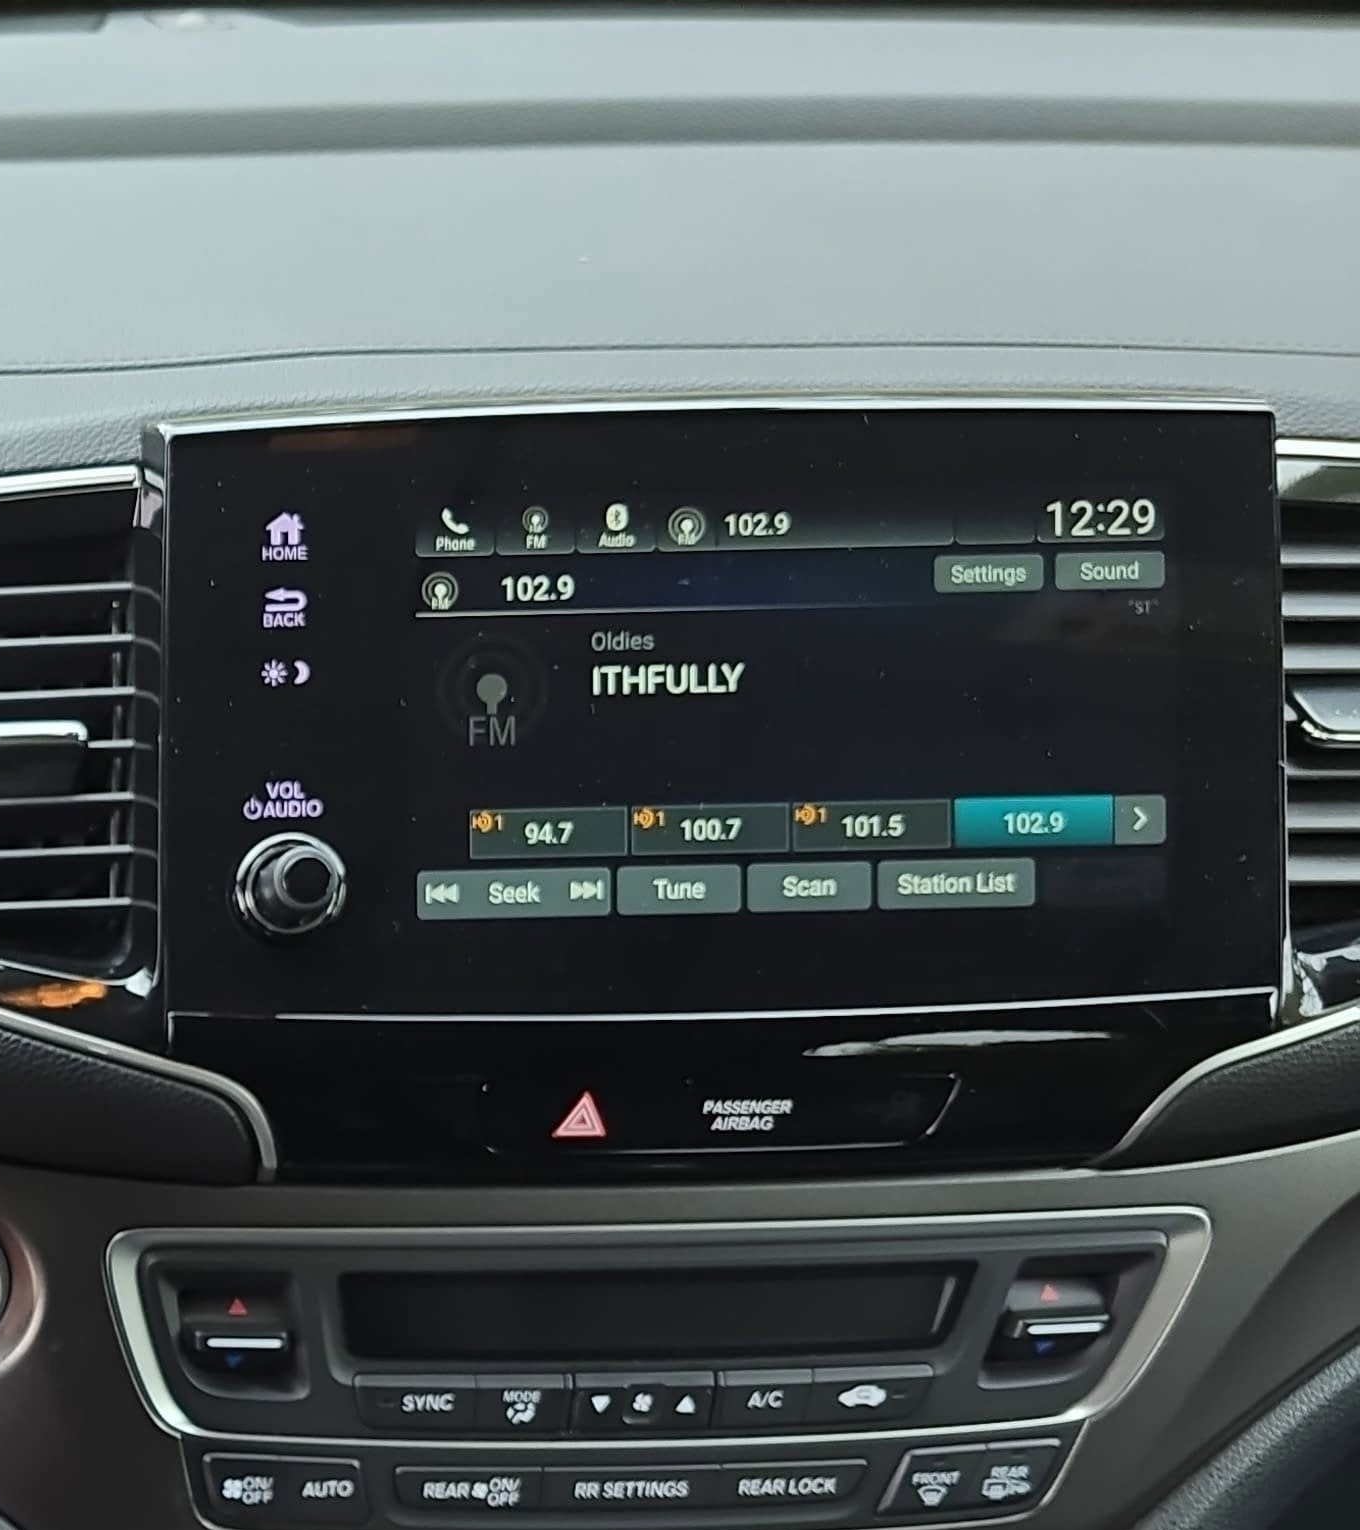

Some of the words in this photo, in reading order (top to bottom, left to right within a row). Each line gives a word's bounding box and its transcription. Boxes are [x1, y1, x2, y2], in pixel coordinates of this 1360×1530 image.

[724, 512, 791, 536] 102.9
[1046, 499, 1156, 537] 12:29
[436, 536, 475, 551] Phone
[526, 535, 546, 549] FM
[599, 532, 634, 547] Audio
[262, 546, 308, 561] HOME
[951, 565, 1026, 586] Settings
[1080, 560, 1140, 581] Sound
[500, 575, 575, 601] 102.9
[263, 613, 306, 627] BACK
[591, 632, 655, 651] Oldies
[591, 663, 745, 696] ITHFULLY
[468, 715, 516, 746] FM
[265, 782, 305, 799] VOL
[263, 801, 324, 818] AUDIO
[680, 817, 743, 842] 100.7
[841, 813, 905, 838] 101.5
[1003, 811, 1065, 834] 102.9
[525, 822, 574, 845] 94.7
[488, 881, 541, 904] Seek
[652, 878, 707, 900] Tune
[782, 876, 837, 897] Scan
[897, 873, 971, 895] Station
[977, 872, 1015, 893] List
[703, 1099, 793, 1114] PASSENGER
[711, 1116, 773, 1131] AIRBAG
[401, 1394, 456, 1412] SYNC
[503, 1390, 540, 1404] MODE
[747, 1391, 784, 1409] A/C
[912, 1471, 961, 1487] FRONT
[990, 1466, 1029, 1480] REAR
[302, 1480, 354, 1498] AUTO
[423, 1481, 468, 1499] REAR
[575, 1482, 601, 1499] RR
[603, 1479, 689, 1499] SETTINGS
[738, 1478, 787, 1496] REAR
[789, 1476, 837, 1495] LOCK
[243, 1490, 273, 1505] OFF
[487, 1491, 519, 1507] OFF
